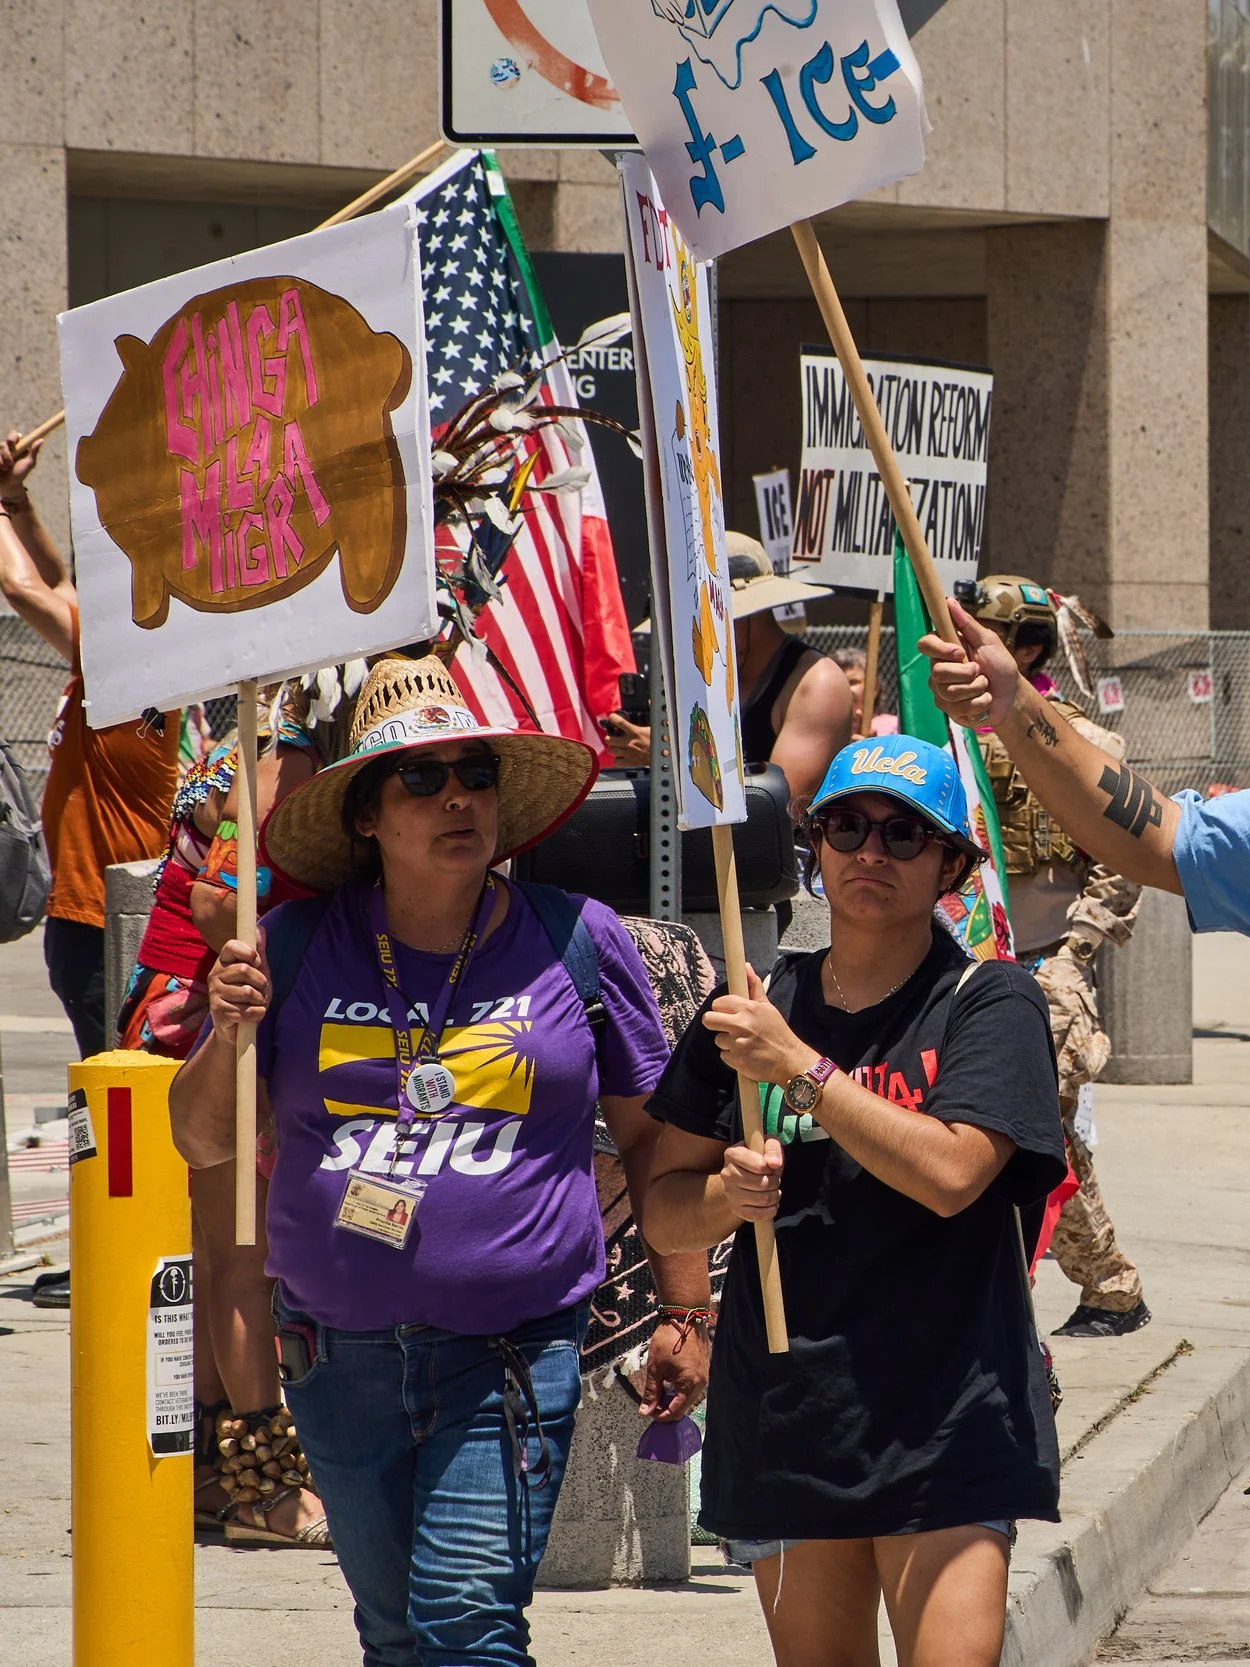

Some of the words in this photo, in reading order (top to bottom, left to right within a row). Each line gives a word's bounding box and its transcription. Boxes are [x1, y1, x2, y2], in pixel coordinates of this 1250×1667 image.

[928, 381, 992, 463] REFORM
[226, 413, 271, 510] LA
[794, 469, 835, 556] NOT
[852, 747, 928, 785] Ucla
[377, 934, 393, 964] SEIU
[469, 996, 532, 1023] 721
[397, 1030, 411, 1069] SEIU
[412, 1074, 431, 1110] MIGRANTS
[425, 1078, 439, 1099] WITH
[436, 1075, 450, 1099] STAND
[320, 1120, 523, 1175] SEIU
[154, 1315, 162, 1323] IS
[164, 1314, 178, 1322] THIS
